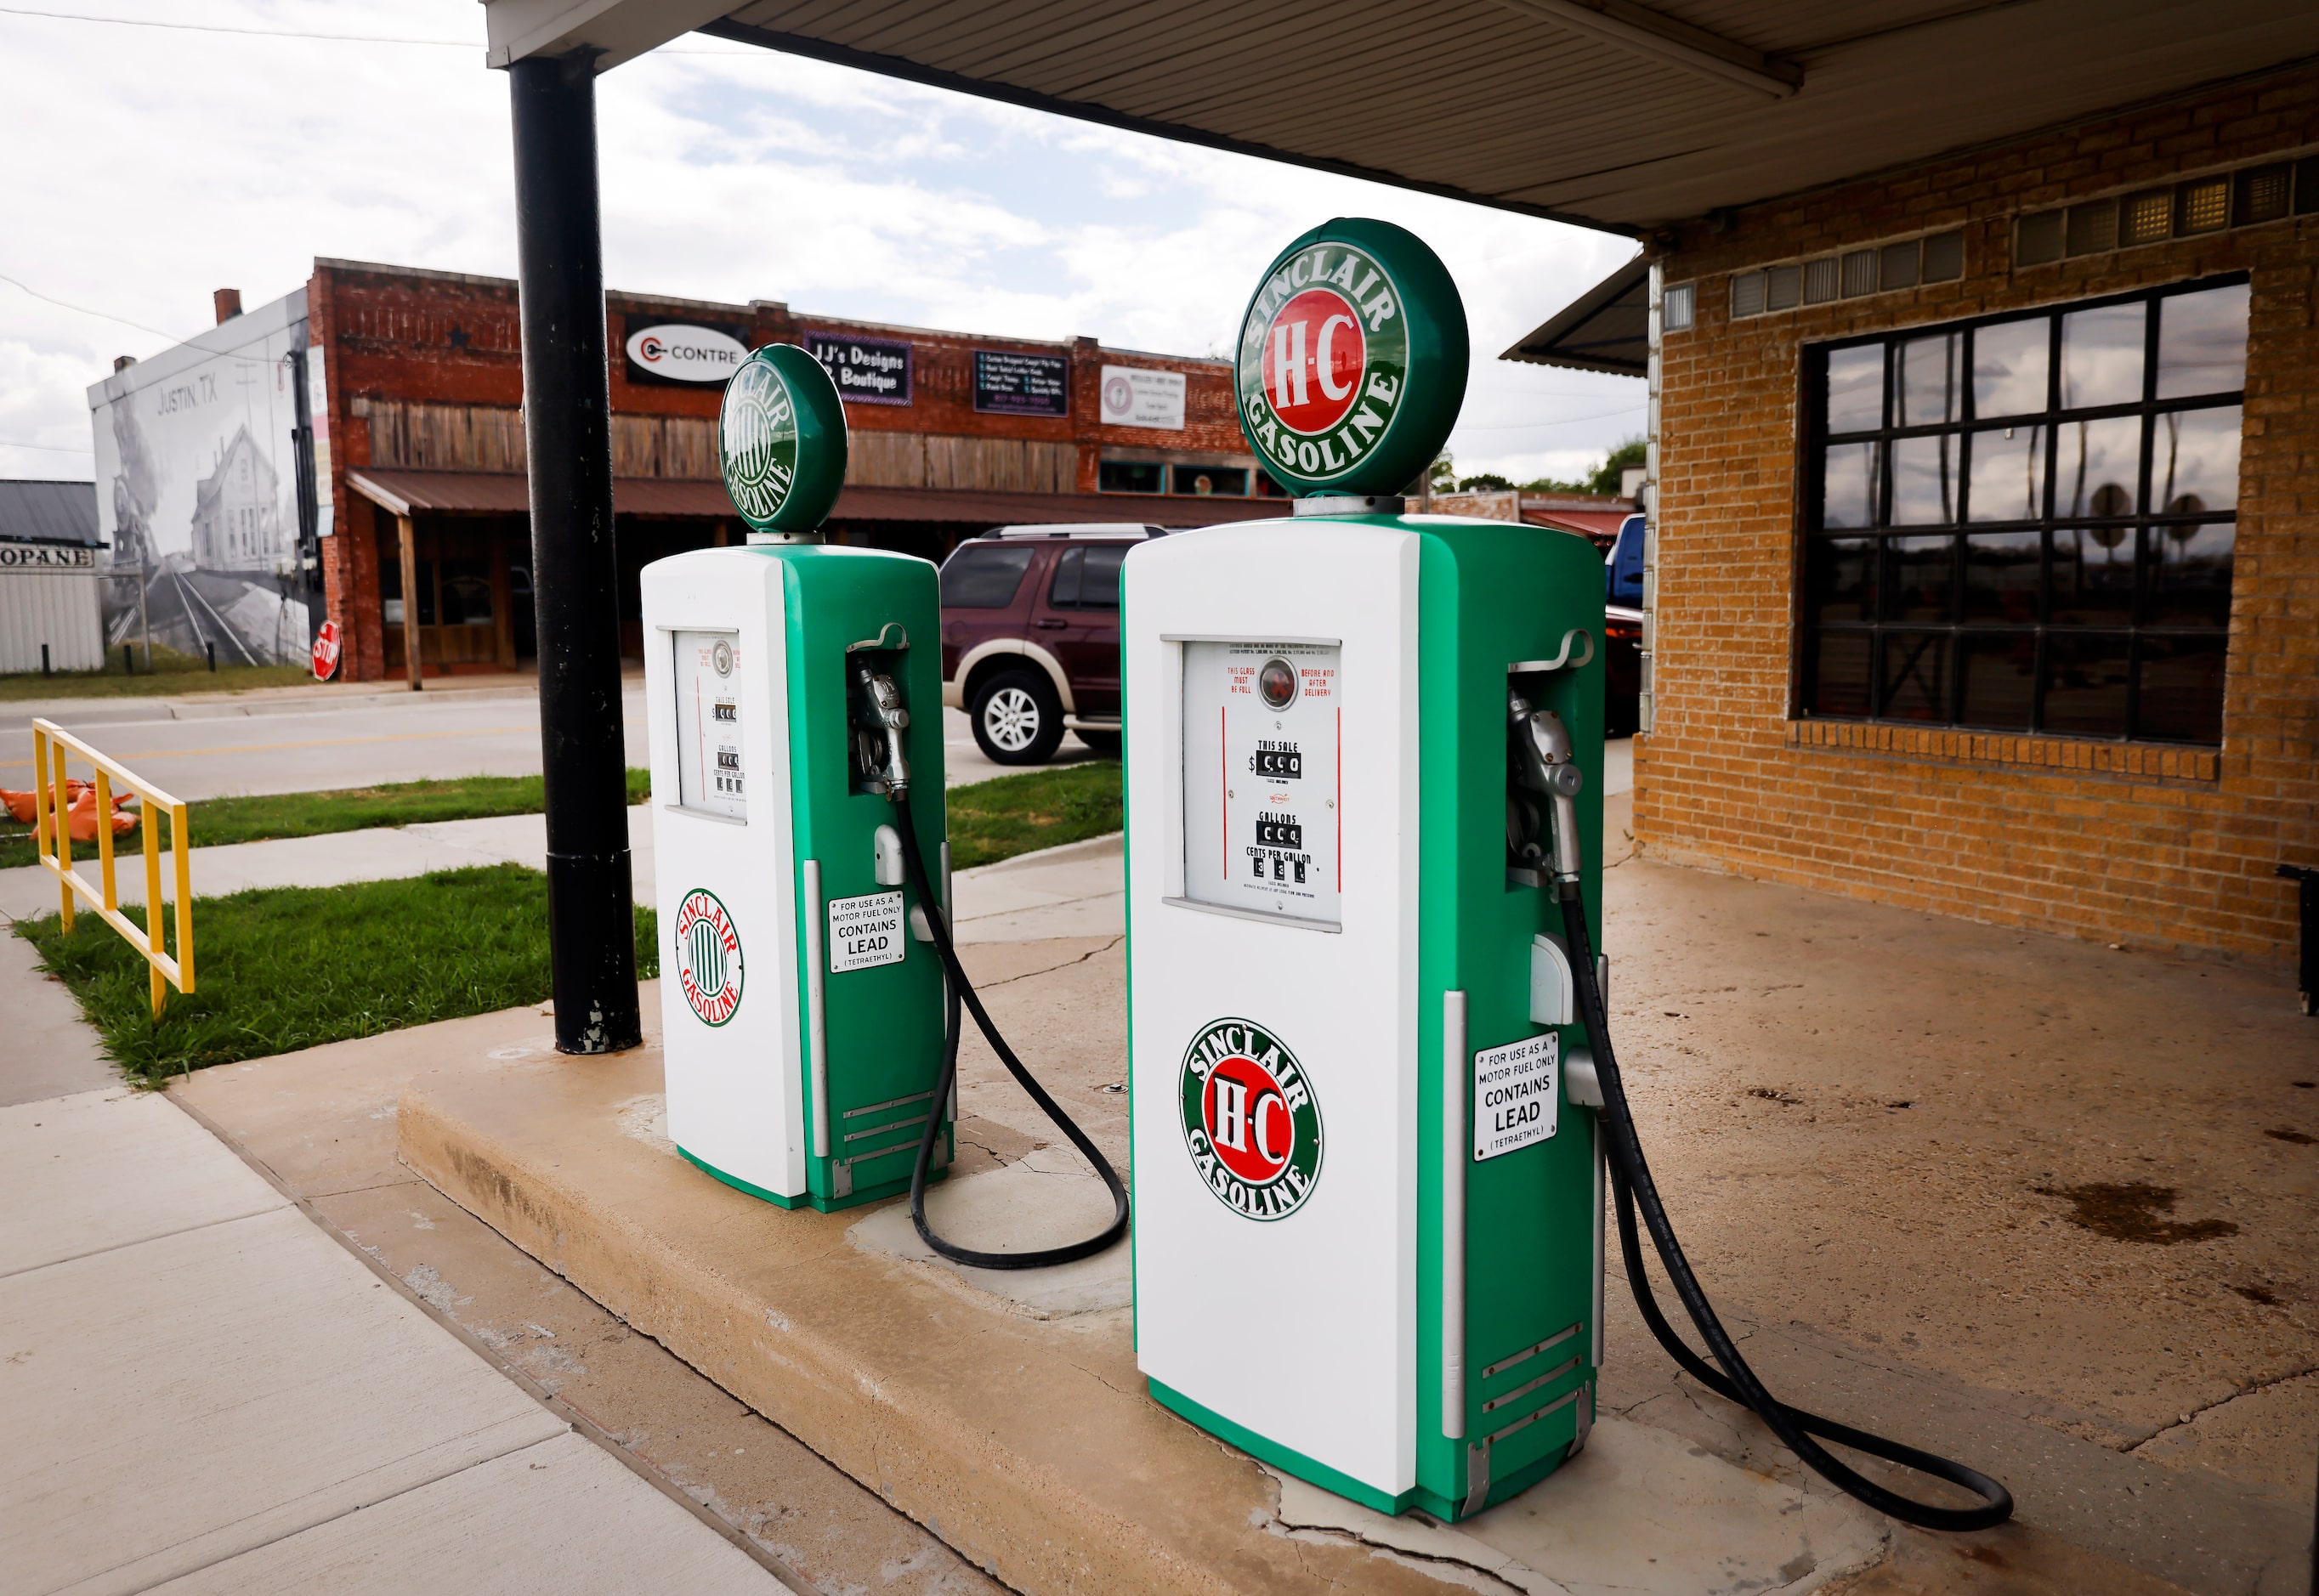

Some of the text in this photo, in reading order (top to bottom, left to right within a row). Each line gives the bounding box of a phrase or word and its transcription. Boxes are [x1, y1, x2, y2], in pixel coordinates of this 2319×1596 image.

[1248, 250, 1396, 349] SINCLAIR
[672, 346, 738, 364] CONTRE
[850, 345, 904, 372] Designs
[200, 372, 218, 404] TX
[840, 366, 897, 393] Boutique
[1248, 371, 1399, 473] GASOLINE
[726, 457, 792, 517] GASOLINE
[313, 637, 338, 665] STOP
[1258, 740, 1297, 752] THIS SALE
[1249, 756, 1255, 773] $
[1259, 811, 1296, 824] GALLONS
[1246, 846, 1311, 864] CENTS PER GALLON
[832, 905, 901, 922] MOTOR FUEL ONLY
[841, 901, 856, 910] FOR
[859, 899, 874, 908] USE
[876, 897, 887, 906] AS
[679, 896, 737, 956] SINCLAIR
[838, 920, 897, 937] CONTAINS
[844, 953, 893, 966] (TETRAETHYL)
[848, 937, 888, 955] LEAD
[683, 968, 738, 1022] GASOLINE
[1488, 1042, 1549, 1067] FOR USE AS A
[1189, 1026, 1310, 1112] SINCLAIR
[1479, 1054, 1556, 1084] MOTOR FUEL ONLY
[1484, 1076, 1551, 1107] CONTAINS
[1494, 1101, 1541, 1132] LEAD
[1489, 1124, 1545, 1150] (TETRAETHYL)
[1190, 1127, 1310, 1215] GASOLINE
